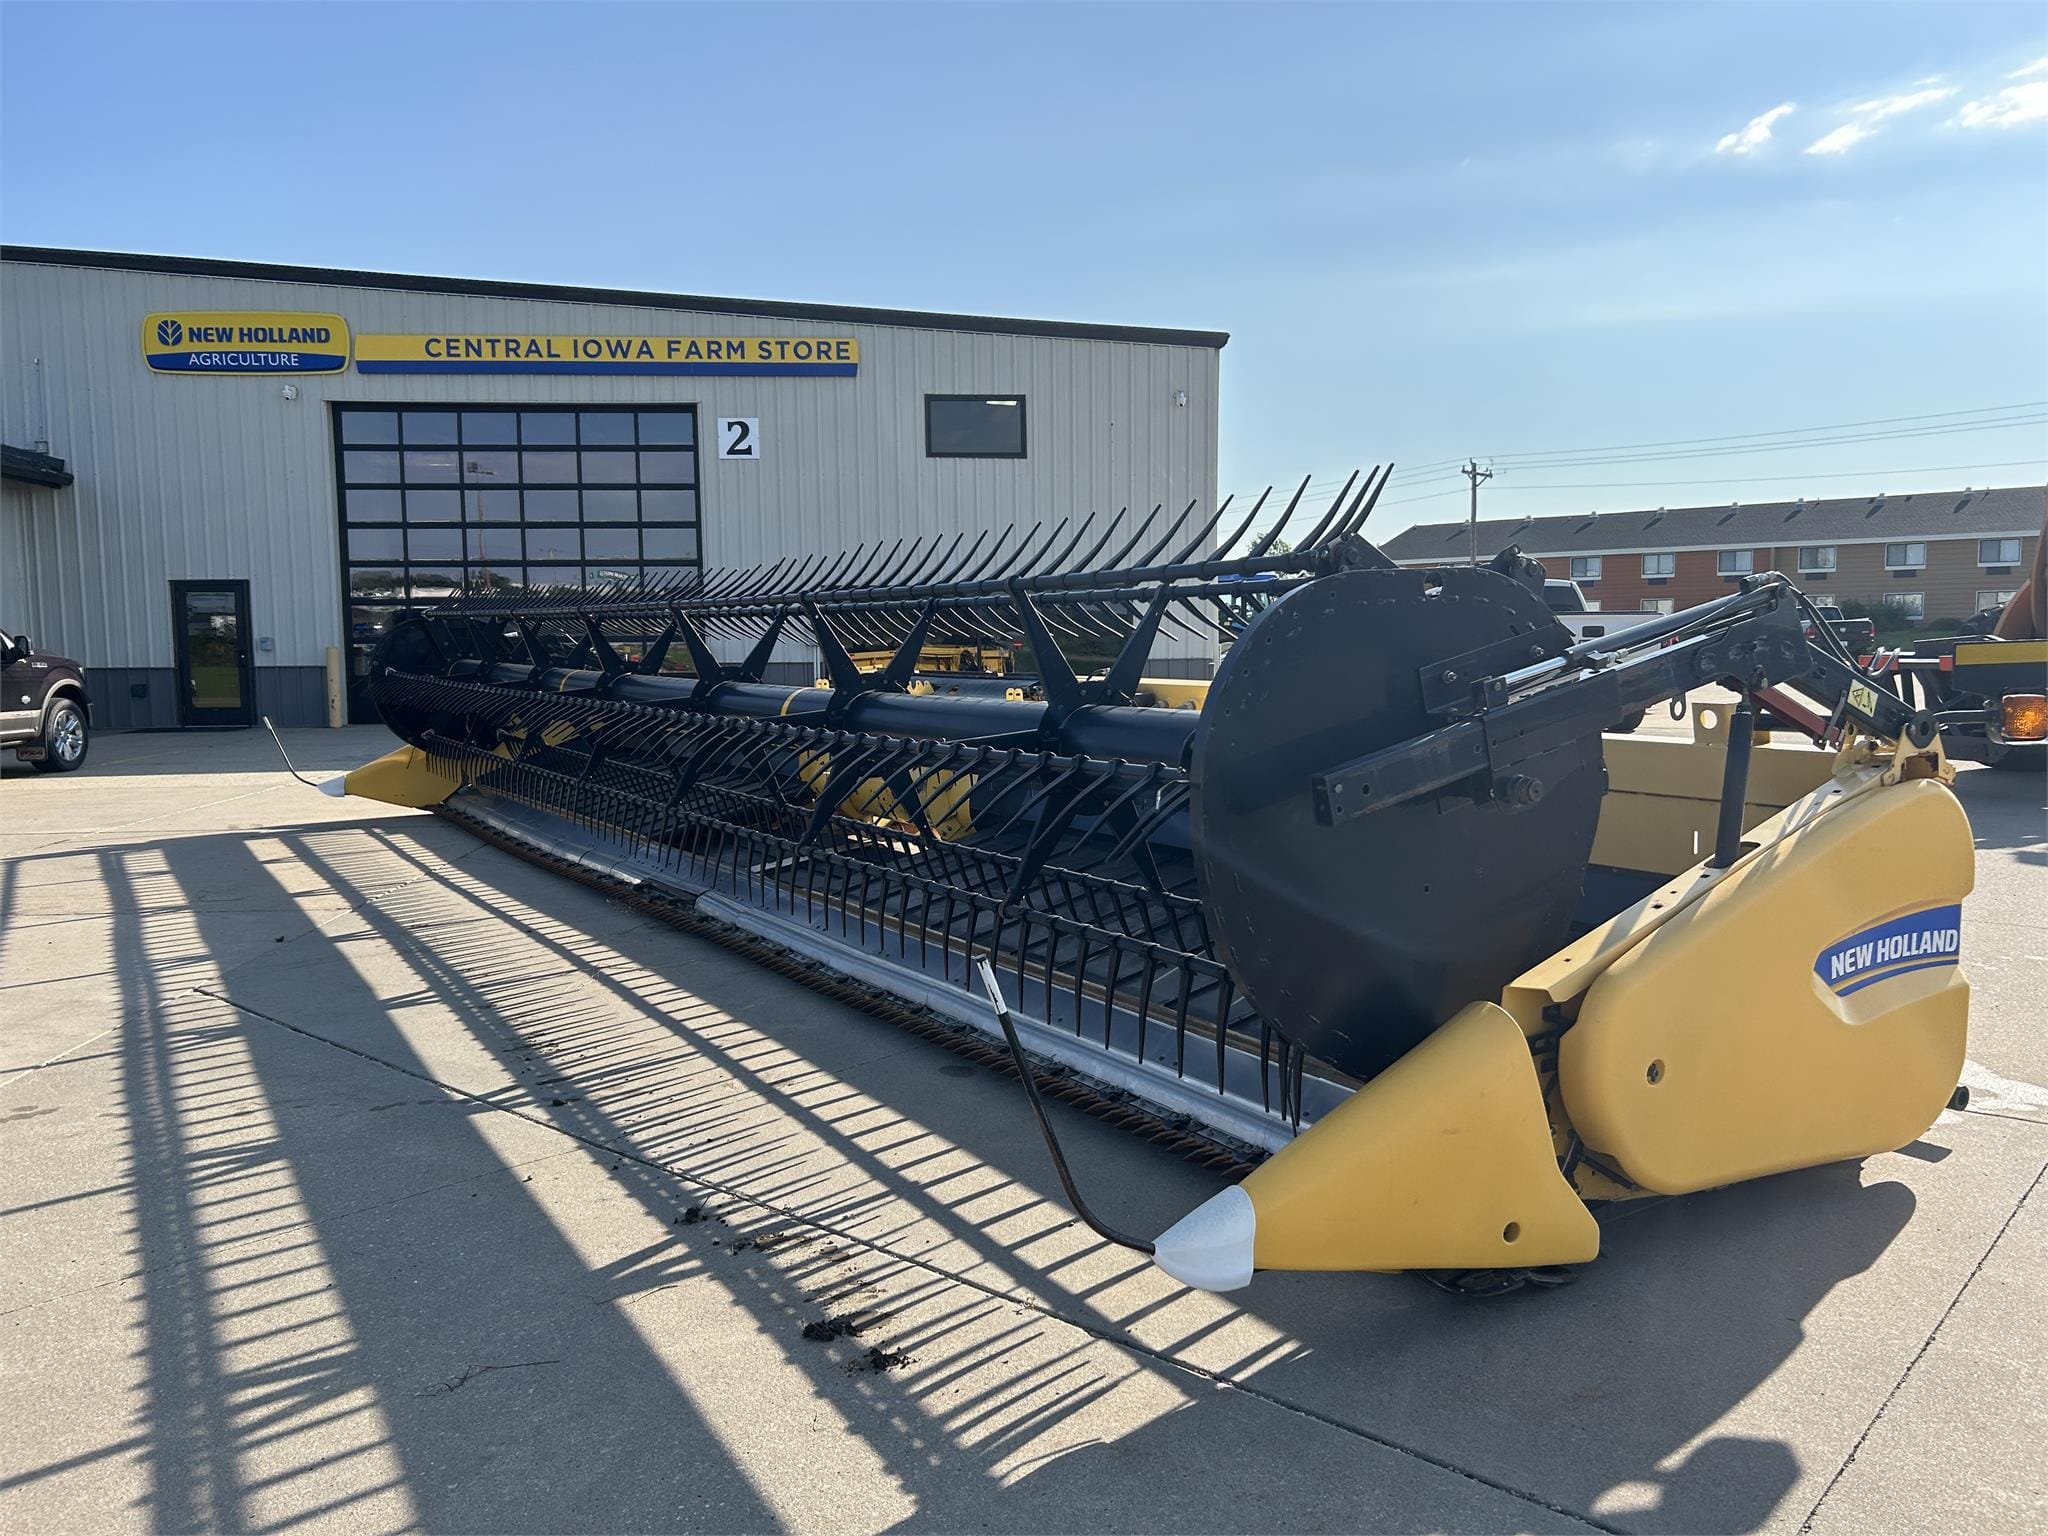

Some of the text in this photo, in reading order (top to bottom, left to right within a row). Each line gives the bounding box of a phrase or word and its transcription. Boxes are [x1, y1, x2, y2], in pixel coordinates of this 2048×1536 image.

[188, 327, 330, 343] NEW HOLLAND
[188, 352, 299, 367] AGRICULTURE
[424, 338, 851, 361] CENTRAL IOWA FARM STORE
[726, 420, 753, 456] 2
[1831, 930, 1958, 979] NEW HOLLAND
